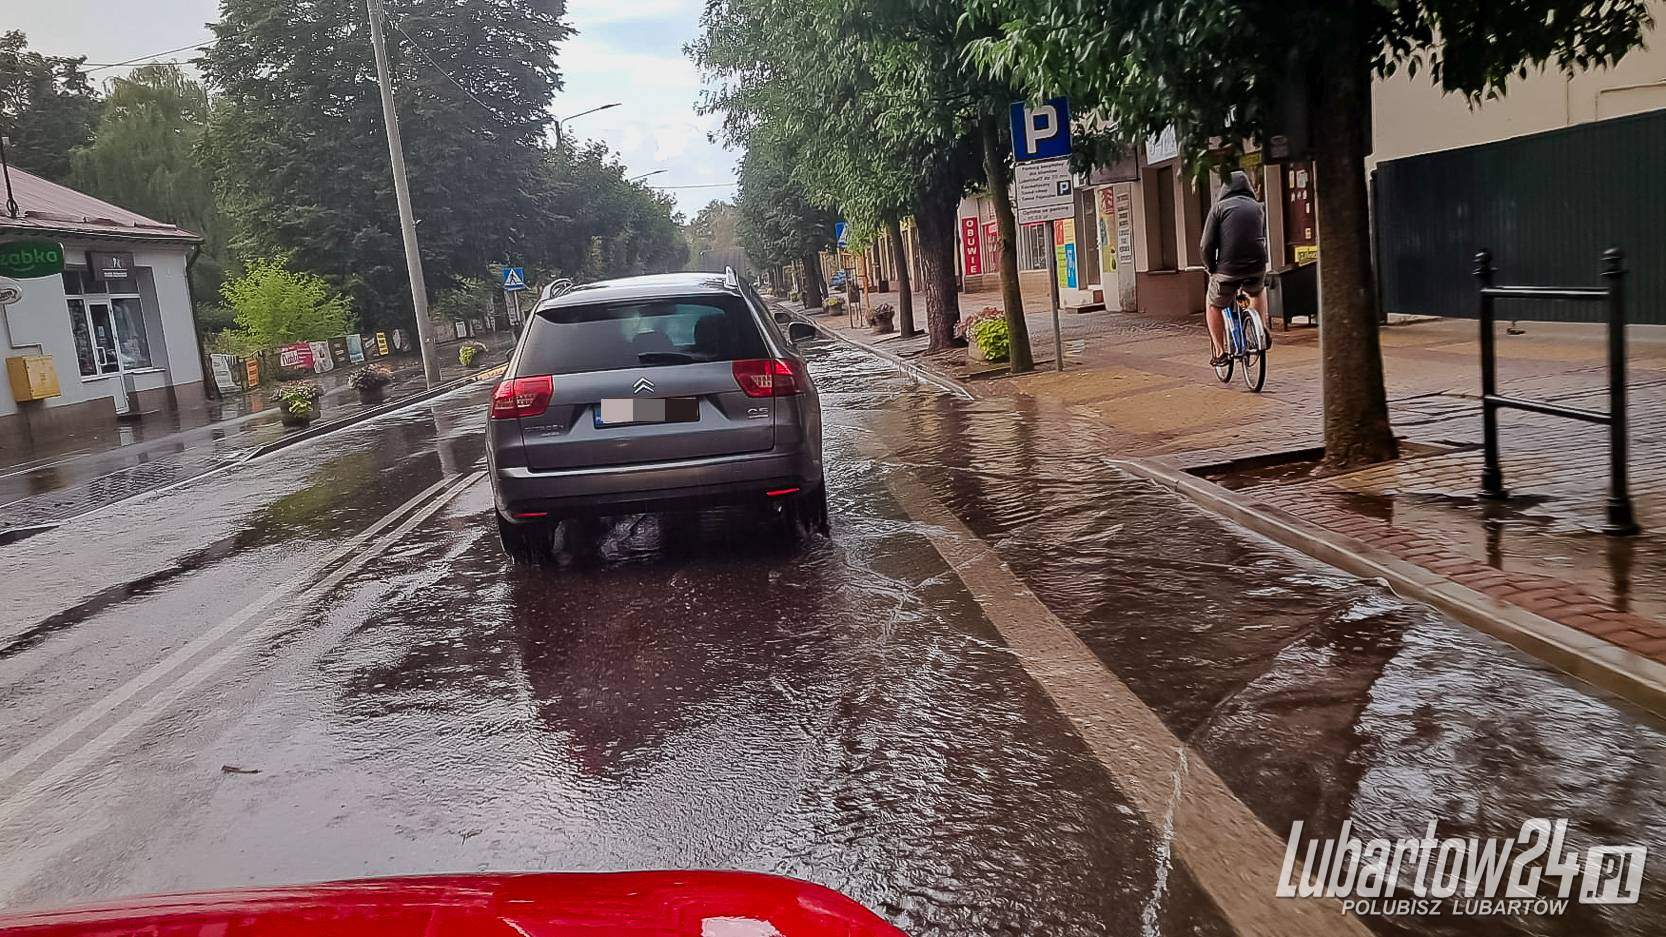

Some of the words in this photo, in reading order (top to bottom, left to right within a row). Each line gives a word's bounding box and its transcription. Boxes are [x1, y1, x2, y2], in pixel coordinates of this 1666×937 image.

[1023, 104, 1058, 154] P
[1060, 182, 1069, 194] P
[966, 220, 977, 273] OBUWIE
